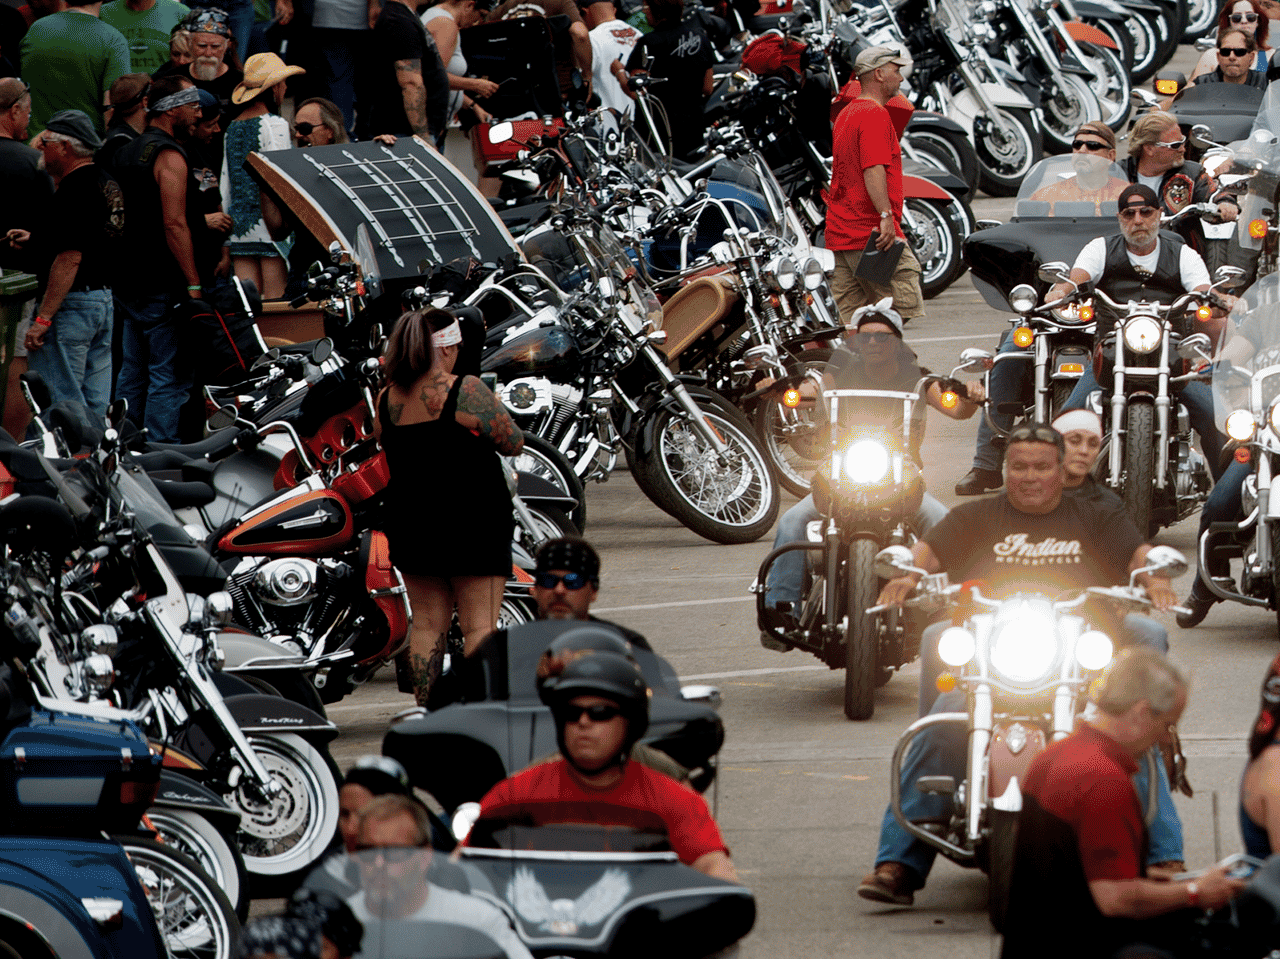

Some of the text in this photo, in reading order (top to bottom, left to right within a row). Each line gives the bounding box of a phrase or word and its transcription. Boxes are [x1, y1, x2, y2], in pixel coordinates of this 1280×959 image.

[670, 30, 702, 58] Harley
[992, 532, 1084, 557] Indian
[994, 555, 1081, 567] MOTORCYCLE
